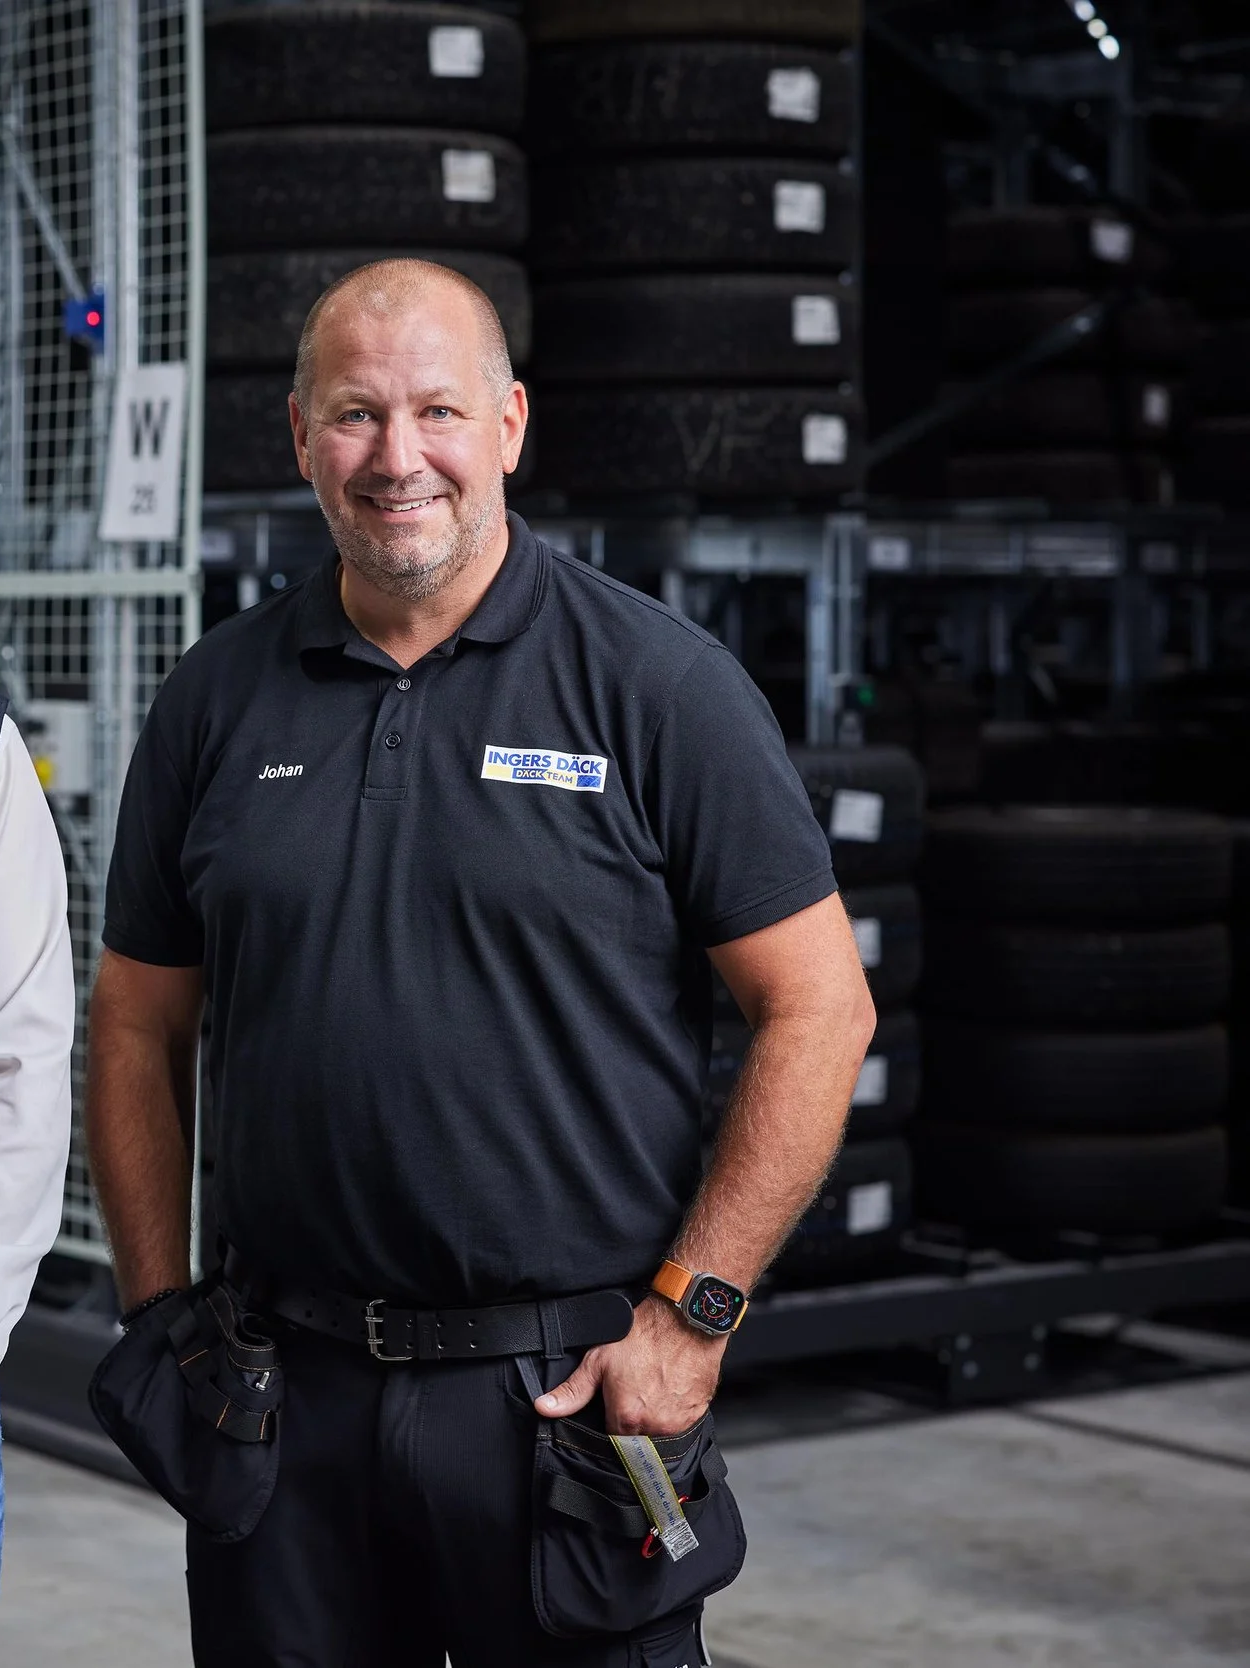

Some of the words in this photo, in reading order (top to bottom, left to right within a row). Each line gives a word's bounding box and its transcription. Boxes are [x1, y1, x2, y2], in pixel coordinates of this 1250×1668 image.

[128, 397, 170, 459] W
[258, 764, 304, 780] Johan
[487, 751, 552, 768] INGERS
[556, 756, 602, 775] DÄCK
[515, 769, 543, 779] DÄCK
[546, 771, 573, 784] TEAM
